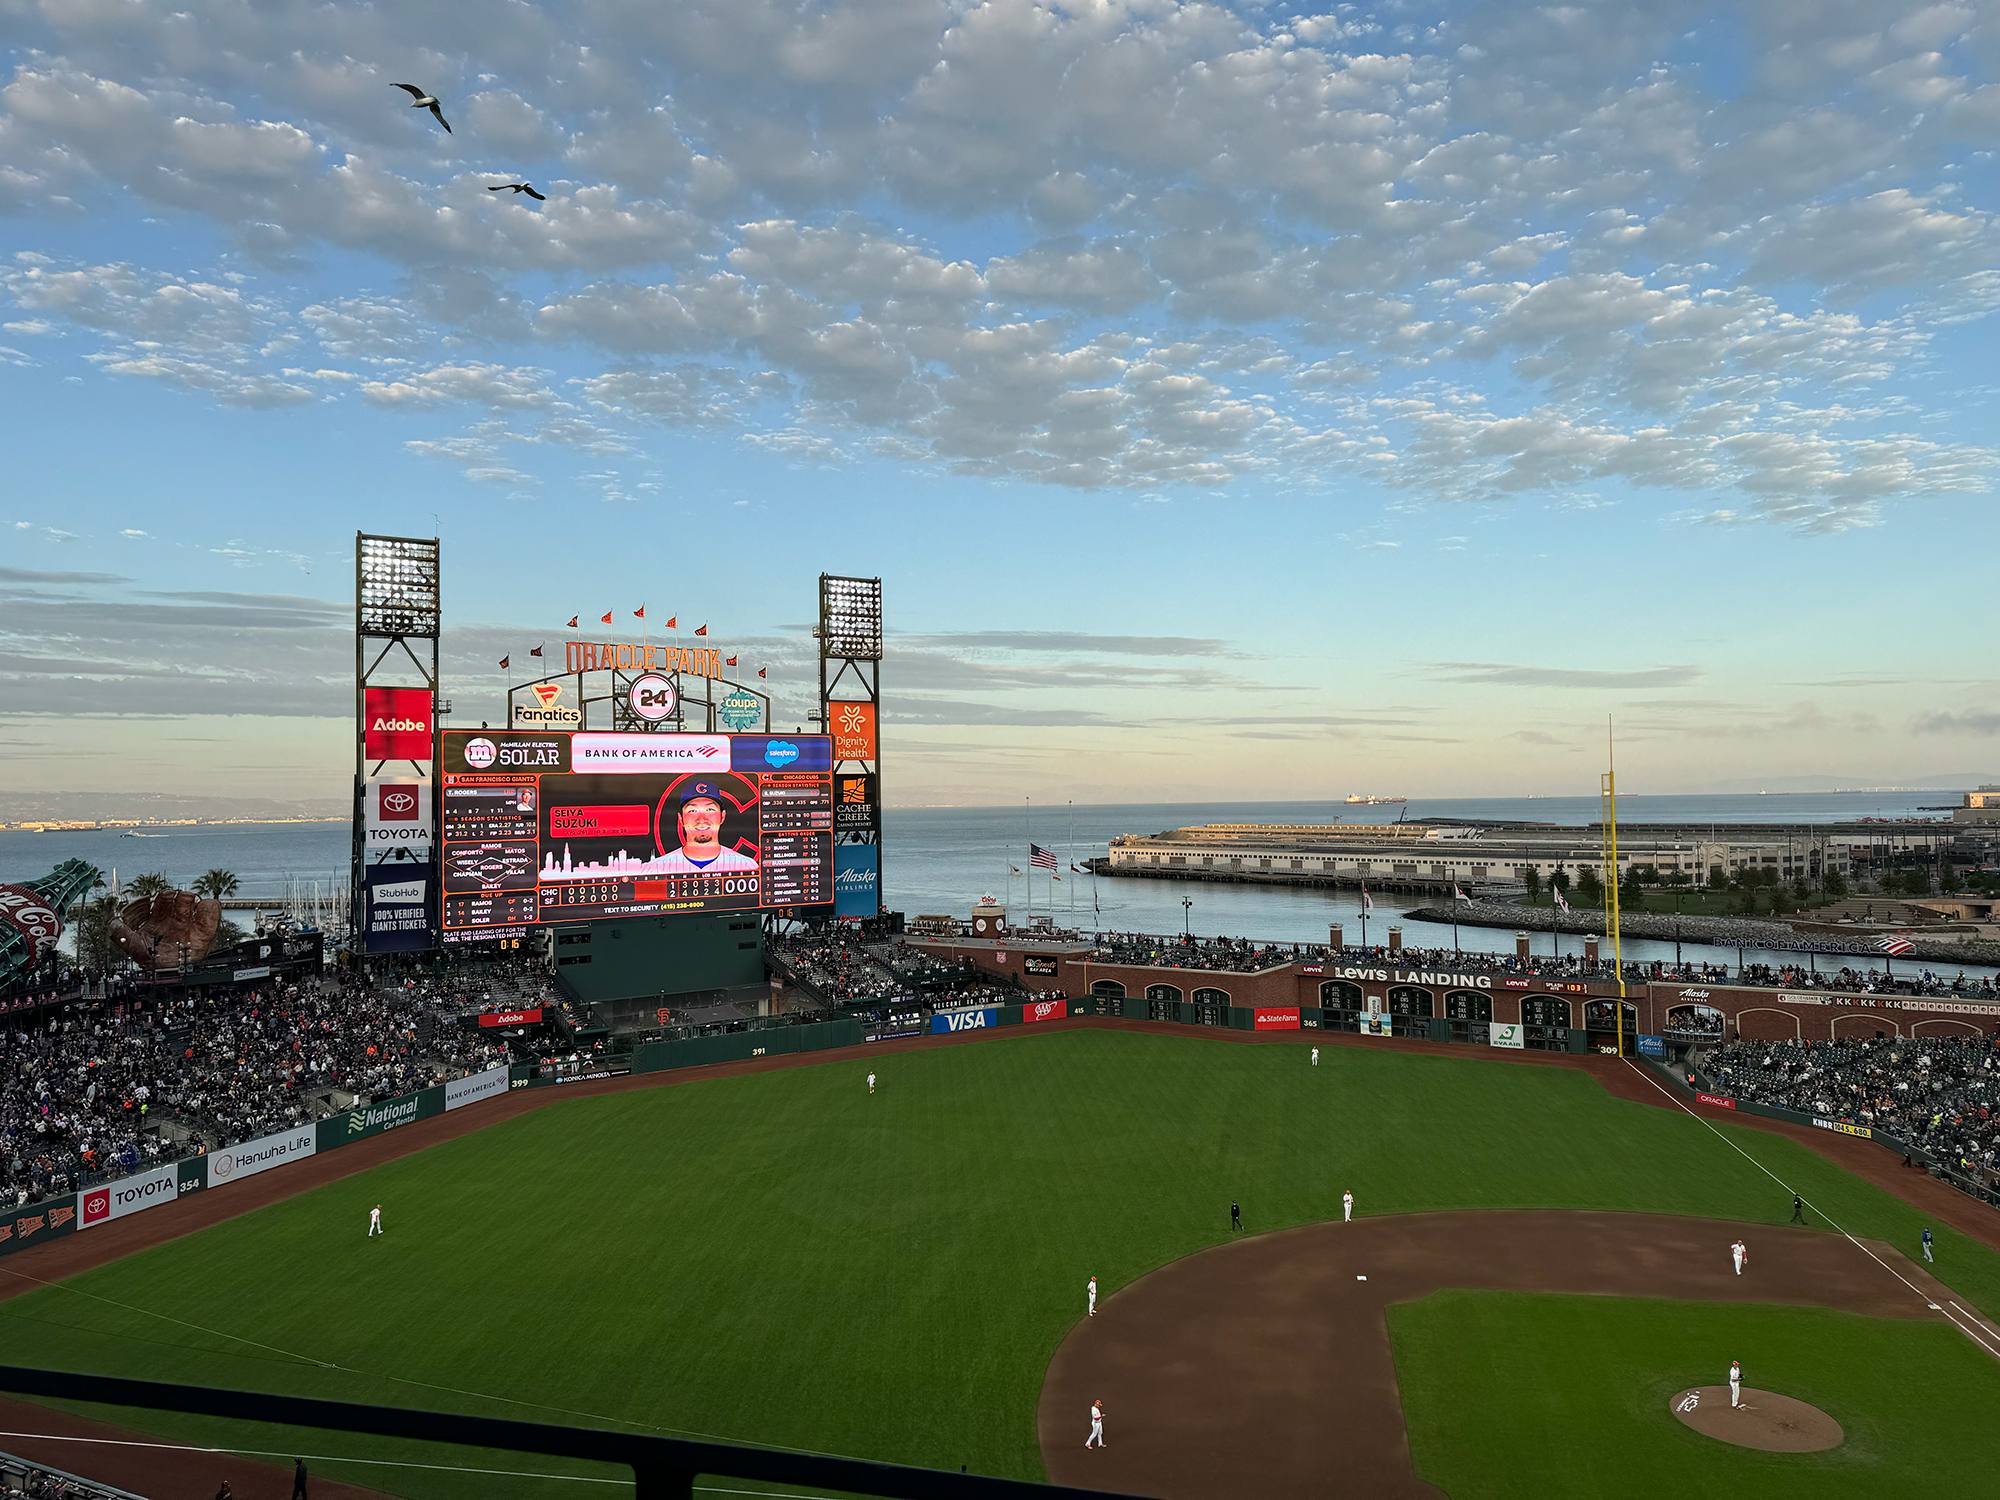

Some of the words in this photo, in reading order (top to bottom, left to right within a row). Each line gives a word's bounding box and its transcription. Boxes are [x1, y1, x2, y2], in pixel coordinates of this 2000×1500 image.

[566, 641, 657, 675] ORACLE
[665, 647, 723, 681] PARK
[640, 689, 669, 707] 24
[725, 699, 757, 710] coupa
[515, 706, 579, 721] Fanatics
[372, 718, 425, 732] Adobe
[836, 736, 869, 748] Dignity
[500, 749, 560, 765] SOLAR
[585, 749, 618, 758] BANK
[622, 749, 637, 758] OF
[638, 749, 694, 758] AMERICA
[769, 749, 797, 757] salesforce
[837, 748, 868, 758] Health
[554, 809, 584, 817] SEIYA
[836, 804, 872, 813] CACHE
[554, 818, 597, 828] SUZUKI
[837, 813, 871, 822] CREEK
[369, 828, 428, 840] TOYOTA
[835, 867, 877, 883] Alaska
[568, 887, 575, 895] 0
[580, 887, 586, 895] 0
[601, 885, 607, 893] 0
[612, 884, 618, 893] 0
[693, 880, 699, 888] 0
[714, 879, 720, 887] 3
[725, 879, 735, 893] 0
[737, 879, 747, 893] 0
[748, 878, 758, 892] 0
[379, 888, 419, 898] StubHub
[544, 897, 554, 905] SF
[568, 896, 575, 904] 0
[580, 895, 586, 903] 2
[590, 894, 597, 902] 0
[612, 893, 618, 901] 0
[669, 890, 676, 898] 2
[682, 889, 688, 897] 4
[693, 888, 699, 896] 0
[703, 888, 710, 896] 2
[714, 887, 720, 895] 4
[630, 904, 659, 912] SECURITY
[660, 903, 676, 911] (415)
[374, 910, 393, 920] 100%
[394, 908, 425, 919] VERIFIED
[839, 914, 860, 922] Coors
[371, 920, 397, 932] GIANTS
[398, 919, 427, 930] TICKETS
[472, 933, 506, 941] DESIGNATED
[1713, 936, 1760, 949] BANK
[1764, 940, 1788, 950] OF
[1790, 941, 1871, 955] AMERICA
[1395, 970, 1492, 989] LANDING
[1679, 987, 1710, 999] Alaska
[933, 1000, 962, 1009] WELCOME
[497, 1014, 524, 1023] Adobe
[944, 1010, 986, 1032] VISA
[752, 1047, 766, 1056] 391
[1600, 1046, 1618, 1054] 309
[563, 1074, 586, 1083] KONICA
[586, 1071, 611, 1080] MINOLTA
[511, 1079, 529, 1088] 399
[446, 1090, 463, 1102] BANK
[463, 1088, 471, 1096] OF
[471, 1081, 496, 1094] AMERICA
[1700, 1095, 1730, 1107] ORACLE
[365, 1096, 418, 1127] National
[383, 1120, 399, 1131] Car
[399, 1113, 416, 1126] Rental
[1812, 1117, 1833, 1130] KNBR
[235, 1147, 287, 1167] Hanwha
[288, 1135, 311, 1152] Life
[115, 1176, 174, 1205] TOYOTA
[179, 1178, 200, 1193] 354
